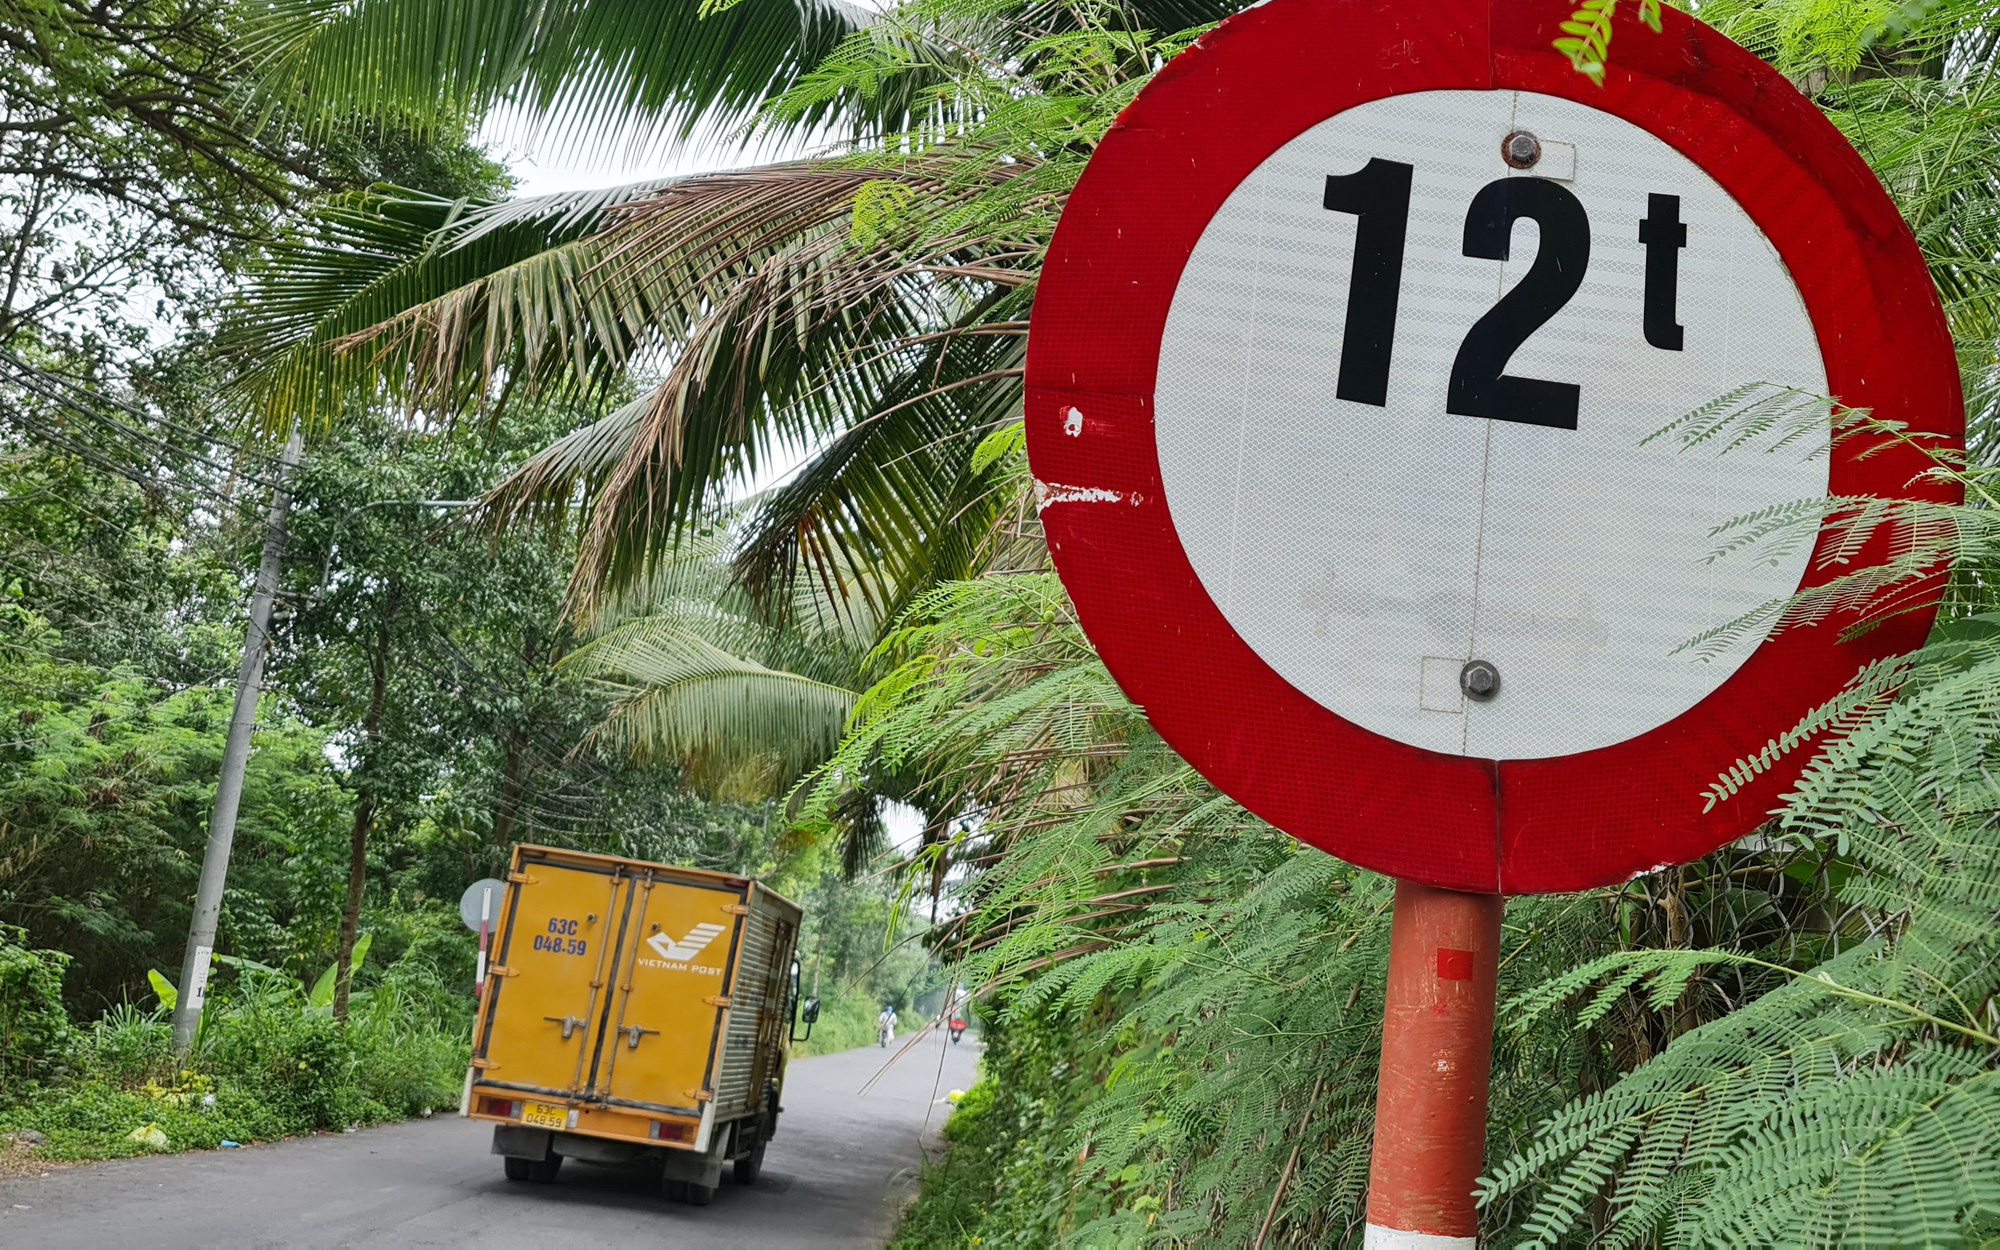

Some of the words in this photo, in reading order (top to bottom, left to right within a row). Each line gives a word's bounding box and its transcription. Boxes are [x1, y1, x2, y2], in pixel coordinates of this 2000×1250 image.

[548, 918, 578, 935] 63C
[533, 934, 587, 956] 048.59
[638, 958, 688, 971] VIETNAM
[691, 964, 722, 976] POST
[537, 1104, 556, 1115] 63C
[526, 1113, 562, 1127] 048.59
